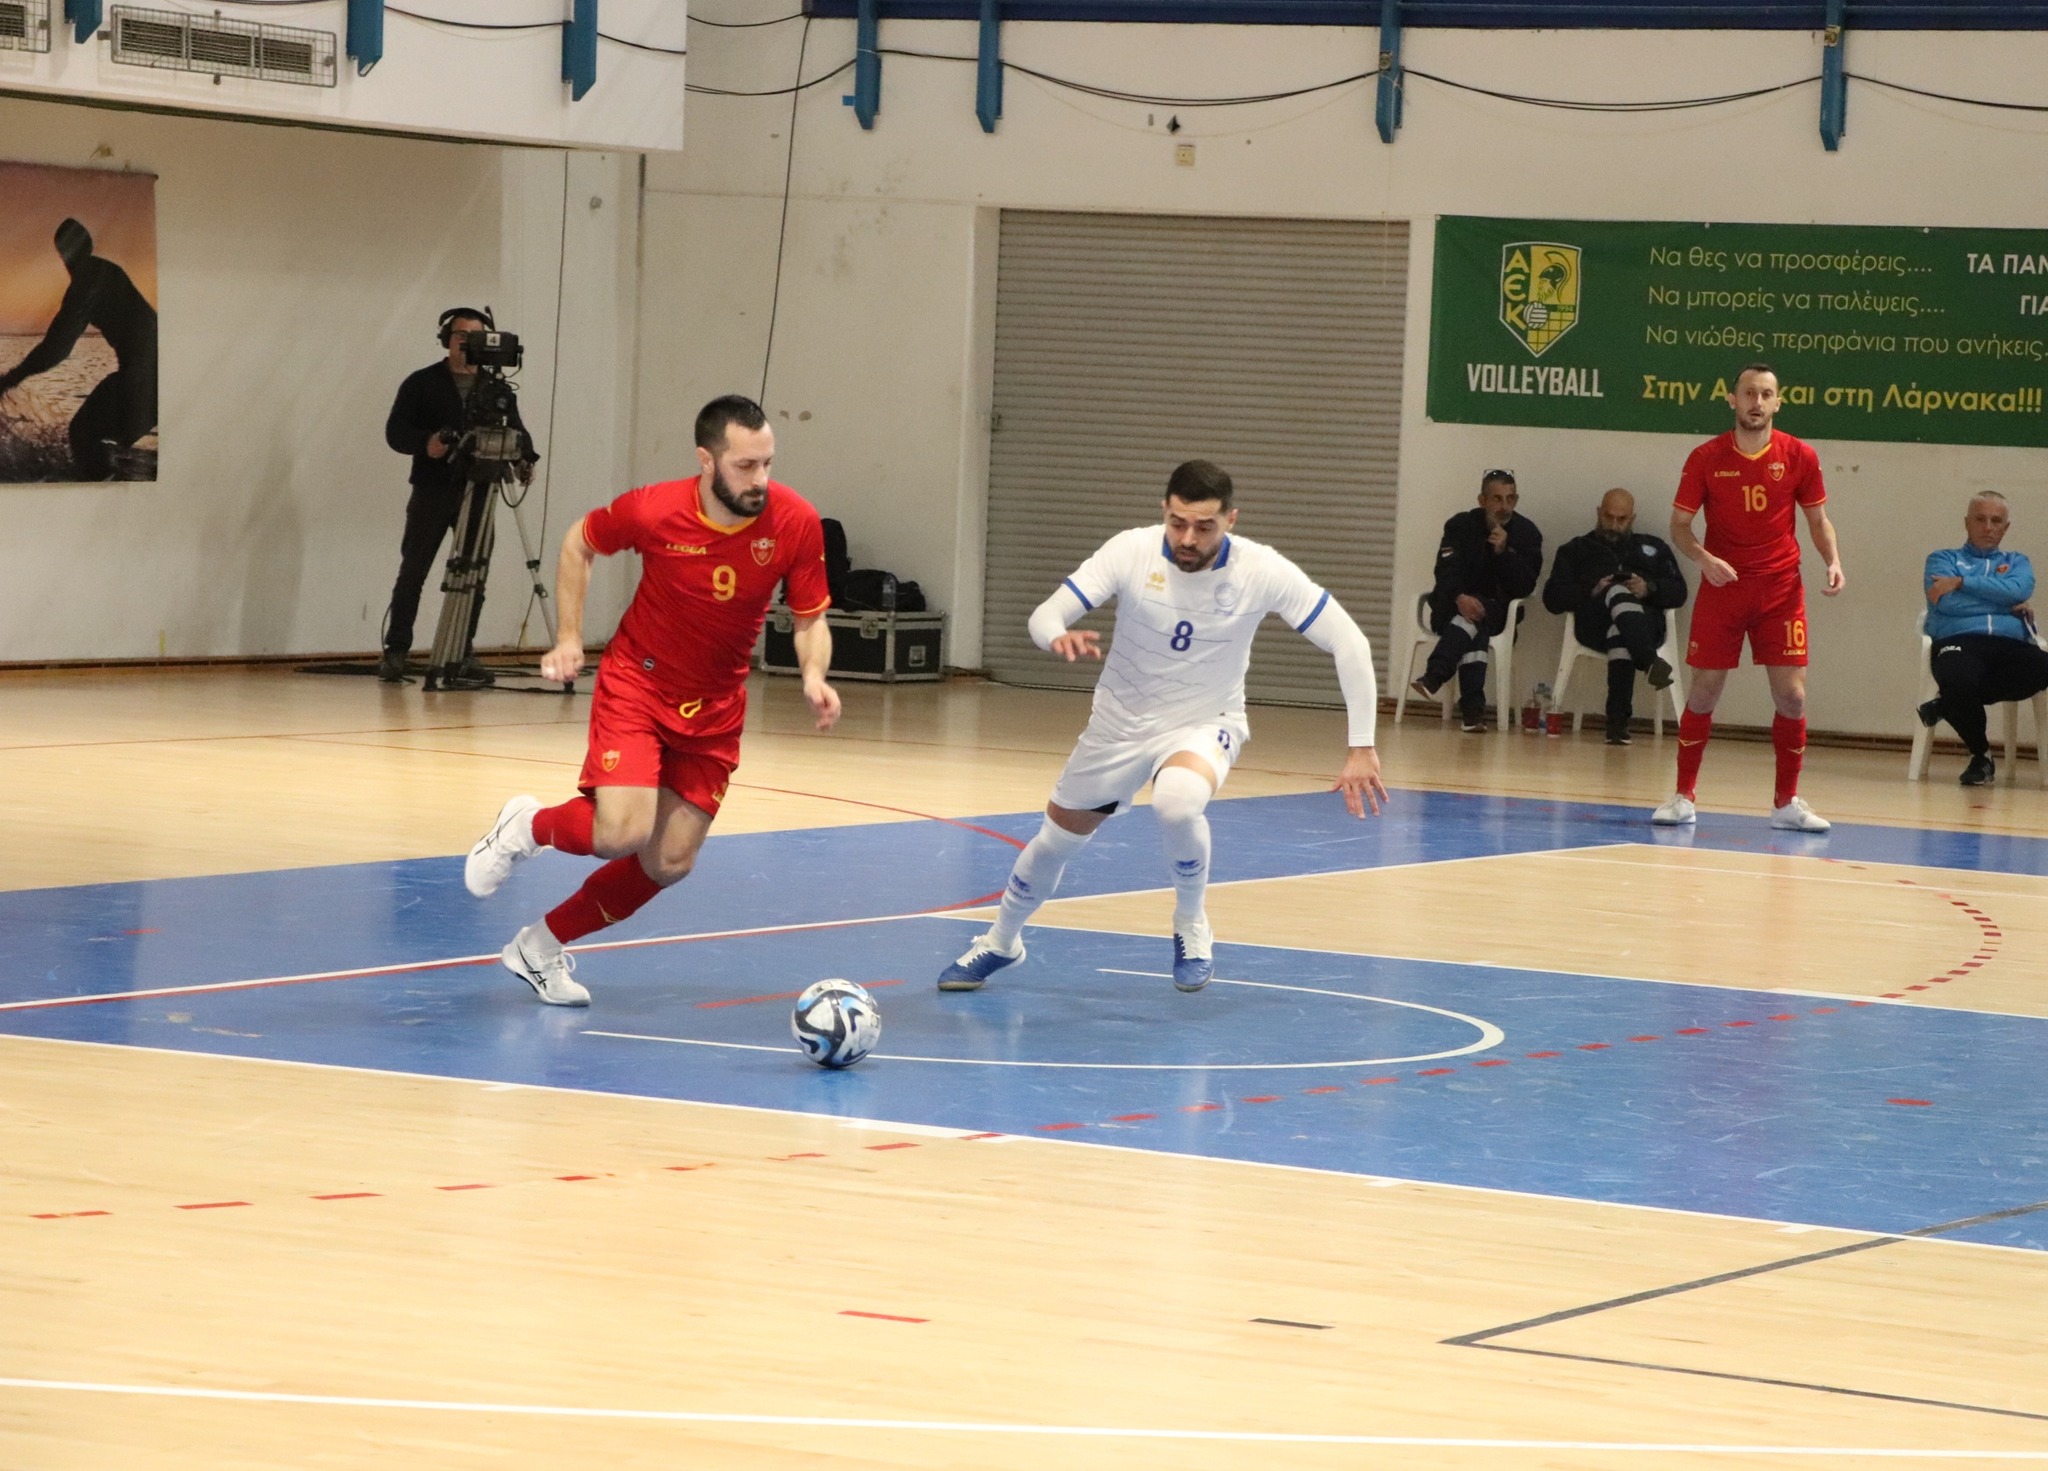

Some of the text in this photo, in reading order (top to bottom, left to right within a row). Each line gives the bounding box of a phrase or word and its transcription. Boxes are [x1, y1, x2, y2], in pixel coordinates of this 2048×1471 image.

[1650, 246, 1682, 267] Να
[1689, 246, 1728, 273] θες
[1734, 252, 1763, 269] να
[1967, 253, 1996, 274] ΤΑ
[1648, 285, 1681, 306] Να
[1686, 286, 1776, 314] μπορείς
[1782, 292, 1811, 310] να
[1645, 324, 1678, 346] Να
[1685, 325, 1766, 353] νιώθεις
[1772, 328, 1896, 355] περηφάνια
[1904, 336, 1950, 354] που
[1467, 363, 1604, 398] VOLLEYBALL
[1642, 374, 1702, 406] Στην
[1823, 386, 1875, 413] στη
[1882, 381, 2042, 415] Λάρνακα!!!
[1741, 484, 1767, 512] 16
[712, 565, 736, 601] 9
[1170, 620, 1194, 652] 8
[1783, 620, 1806, 648] 16
